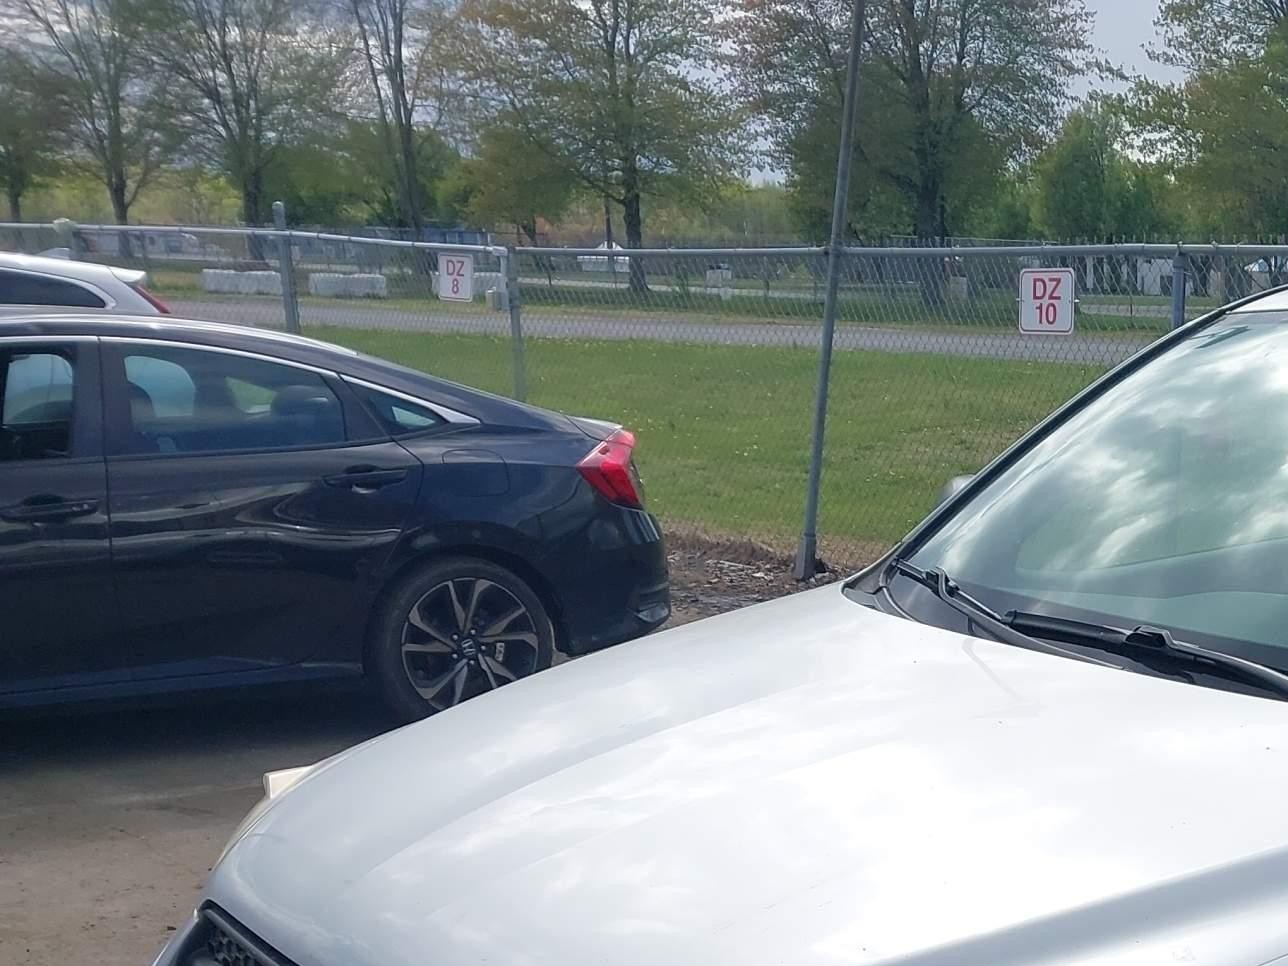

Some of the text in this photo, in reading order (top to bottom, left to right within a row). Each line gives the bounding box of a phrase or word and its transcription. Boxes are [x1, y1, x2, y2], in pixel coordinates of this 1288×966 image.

[447, 260, 465, 277] DZ
[452, 279, 460, 294] 8
[1032, 277, 1062, 301] DZ
[1035, 302, 1057, 325] 10
